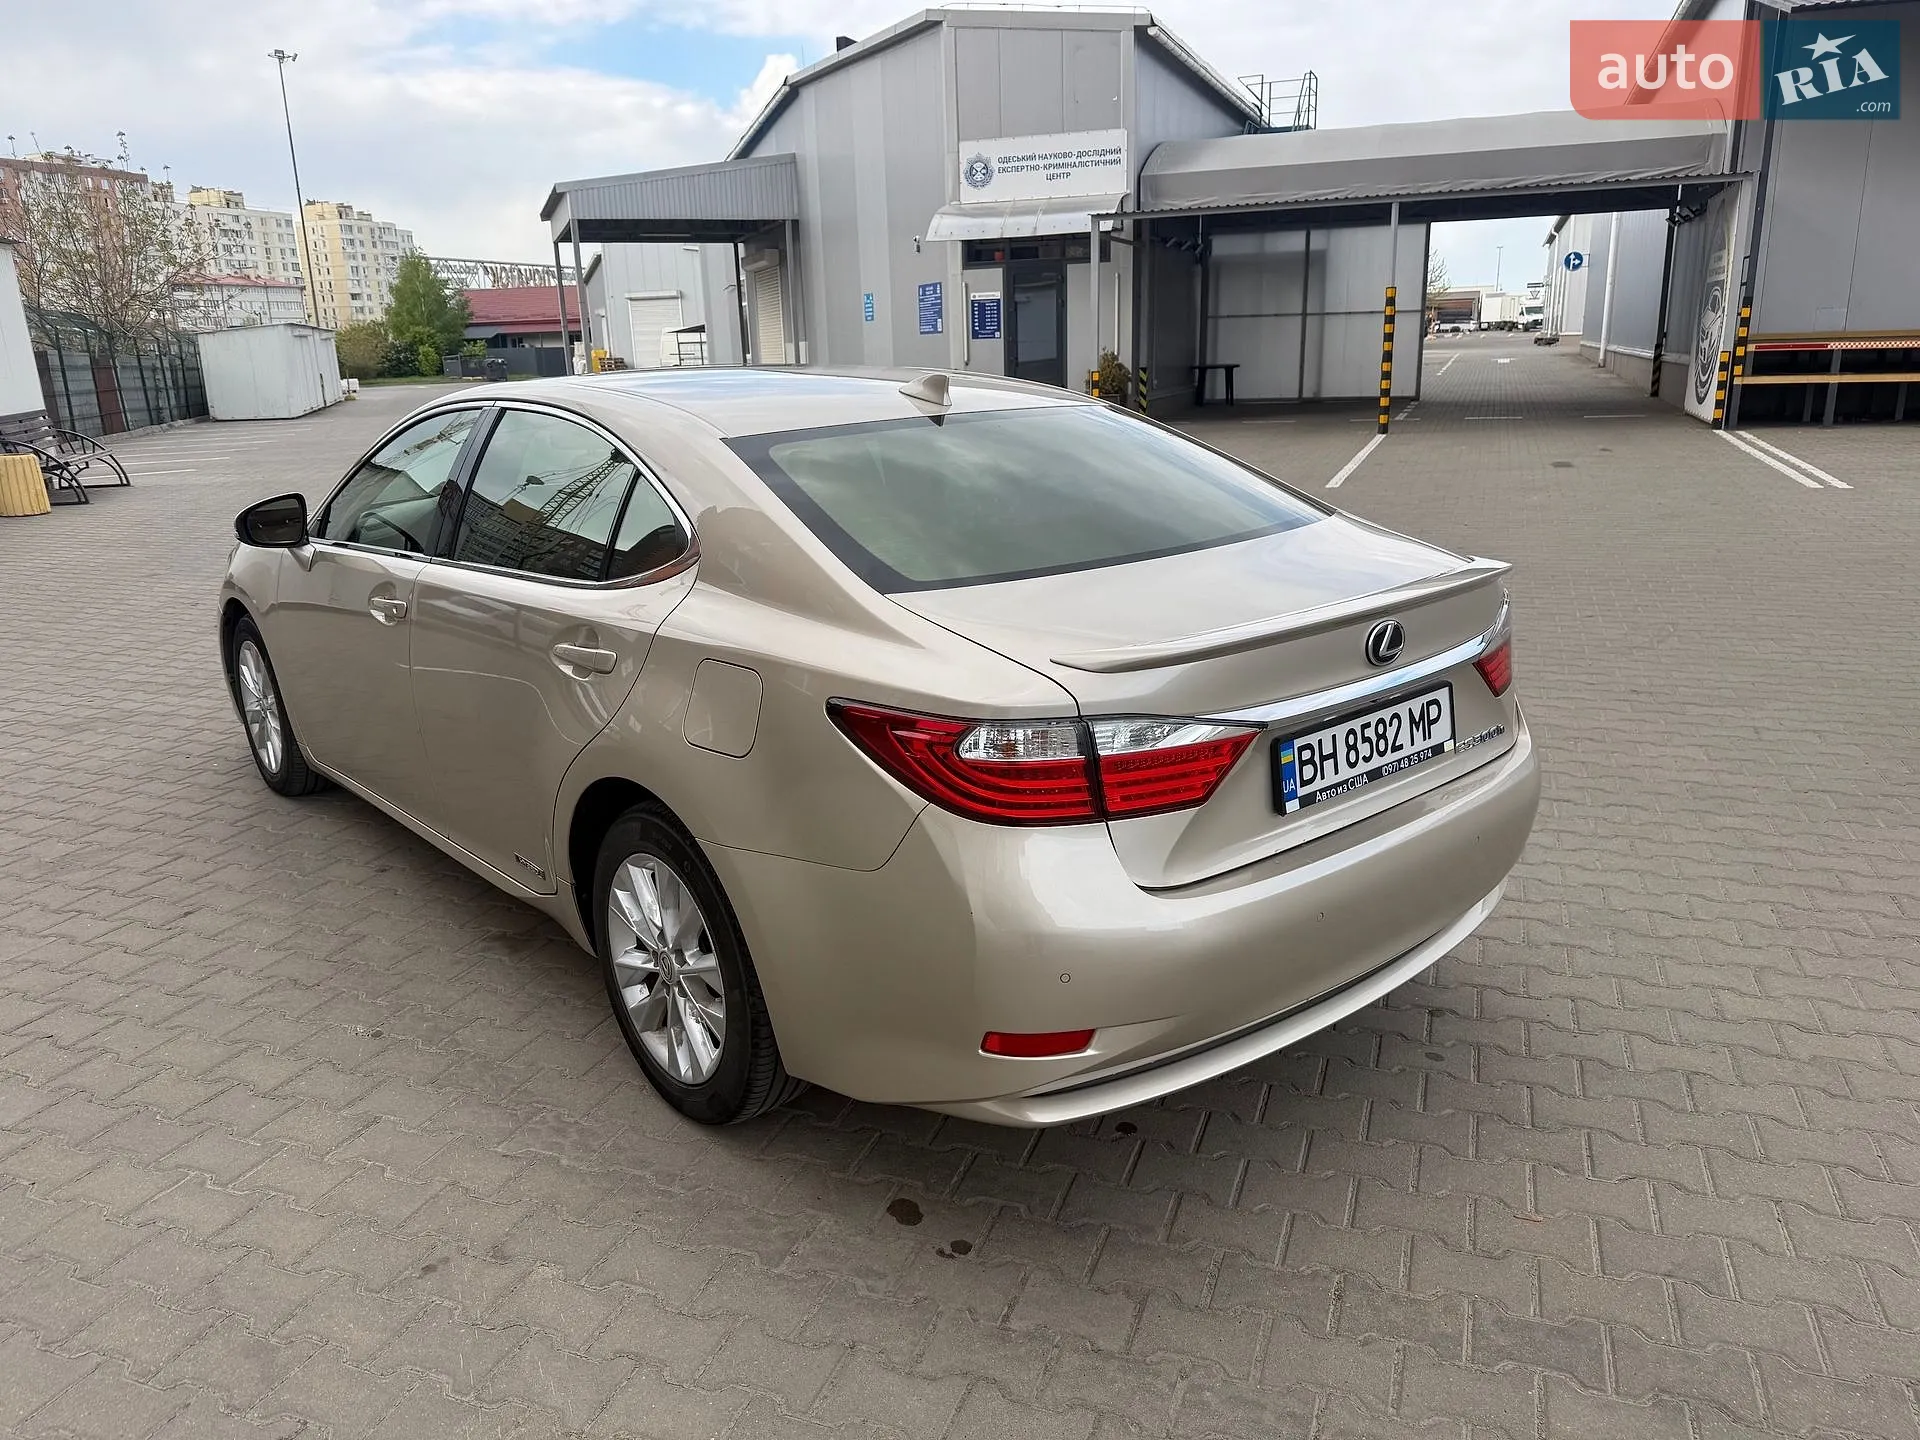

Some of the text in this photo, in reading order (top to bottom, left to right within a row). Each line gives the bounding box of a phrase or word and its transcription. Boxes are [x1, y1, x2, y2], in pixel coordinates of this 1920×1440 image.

[997, 147, 1122, 165] ОДЕСЬКИЙ НАУКОВО-ДОСЛІДНИЙ
[997, 158, 1122, 174] ЕКСПЕРТНО-КРИМІНАЛІСТИЧНИЙ
[1046, 172, 1071, 182] ЦЕНТР
[1297, 698, 1442, 789] BH 8582 MP
[1382, 750, 1433, 777] (097) 48 25 974
[1283, 780, 1296, 794] UA
[1315, 774, 1369, 803] Авто из США
